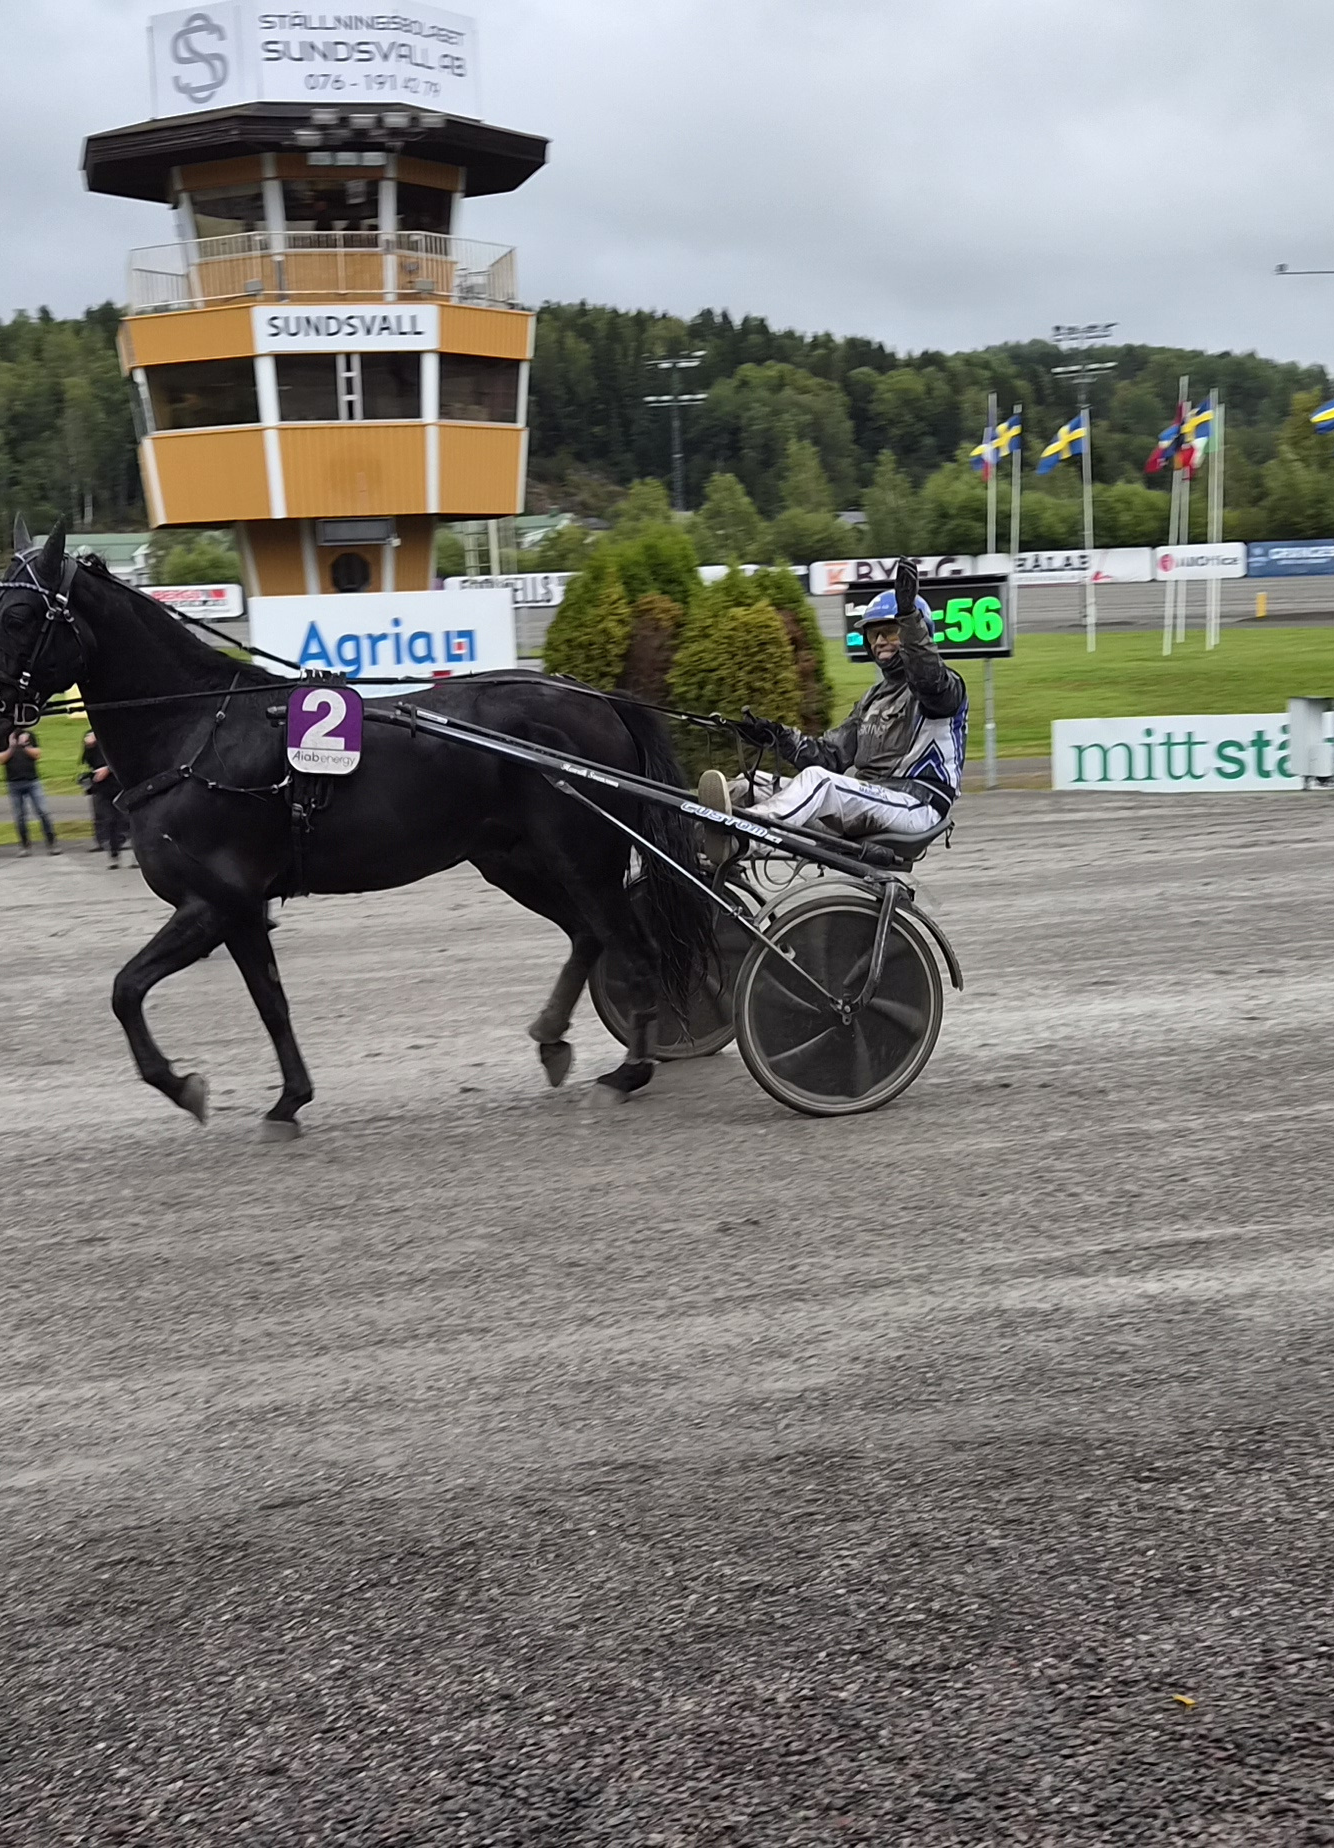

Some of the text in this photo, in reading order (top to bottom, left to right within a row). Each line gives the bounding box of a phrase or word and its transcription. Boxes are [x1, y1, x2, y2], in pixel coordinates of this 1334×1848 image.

[261, 40, 467, 77] SUNDSVALL AB
[304, 73, 346, 91] 076
[363, 73, 398, 91] 191
[267, 314, 425, 338] SUNDSVALL
[297, 616, 438, 679] Agria
[300, 688, 347, 751] 2
